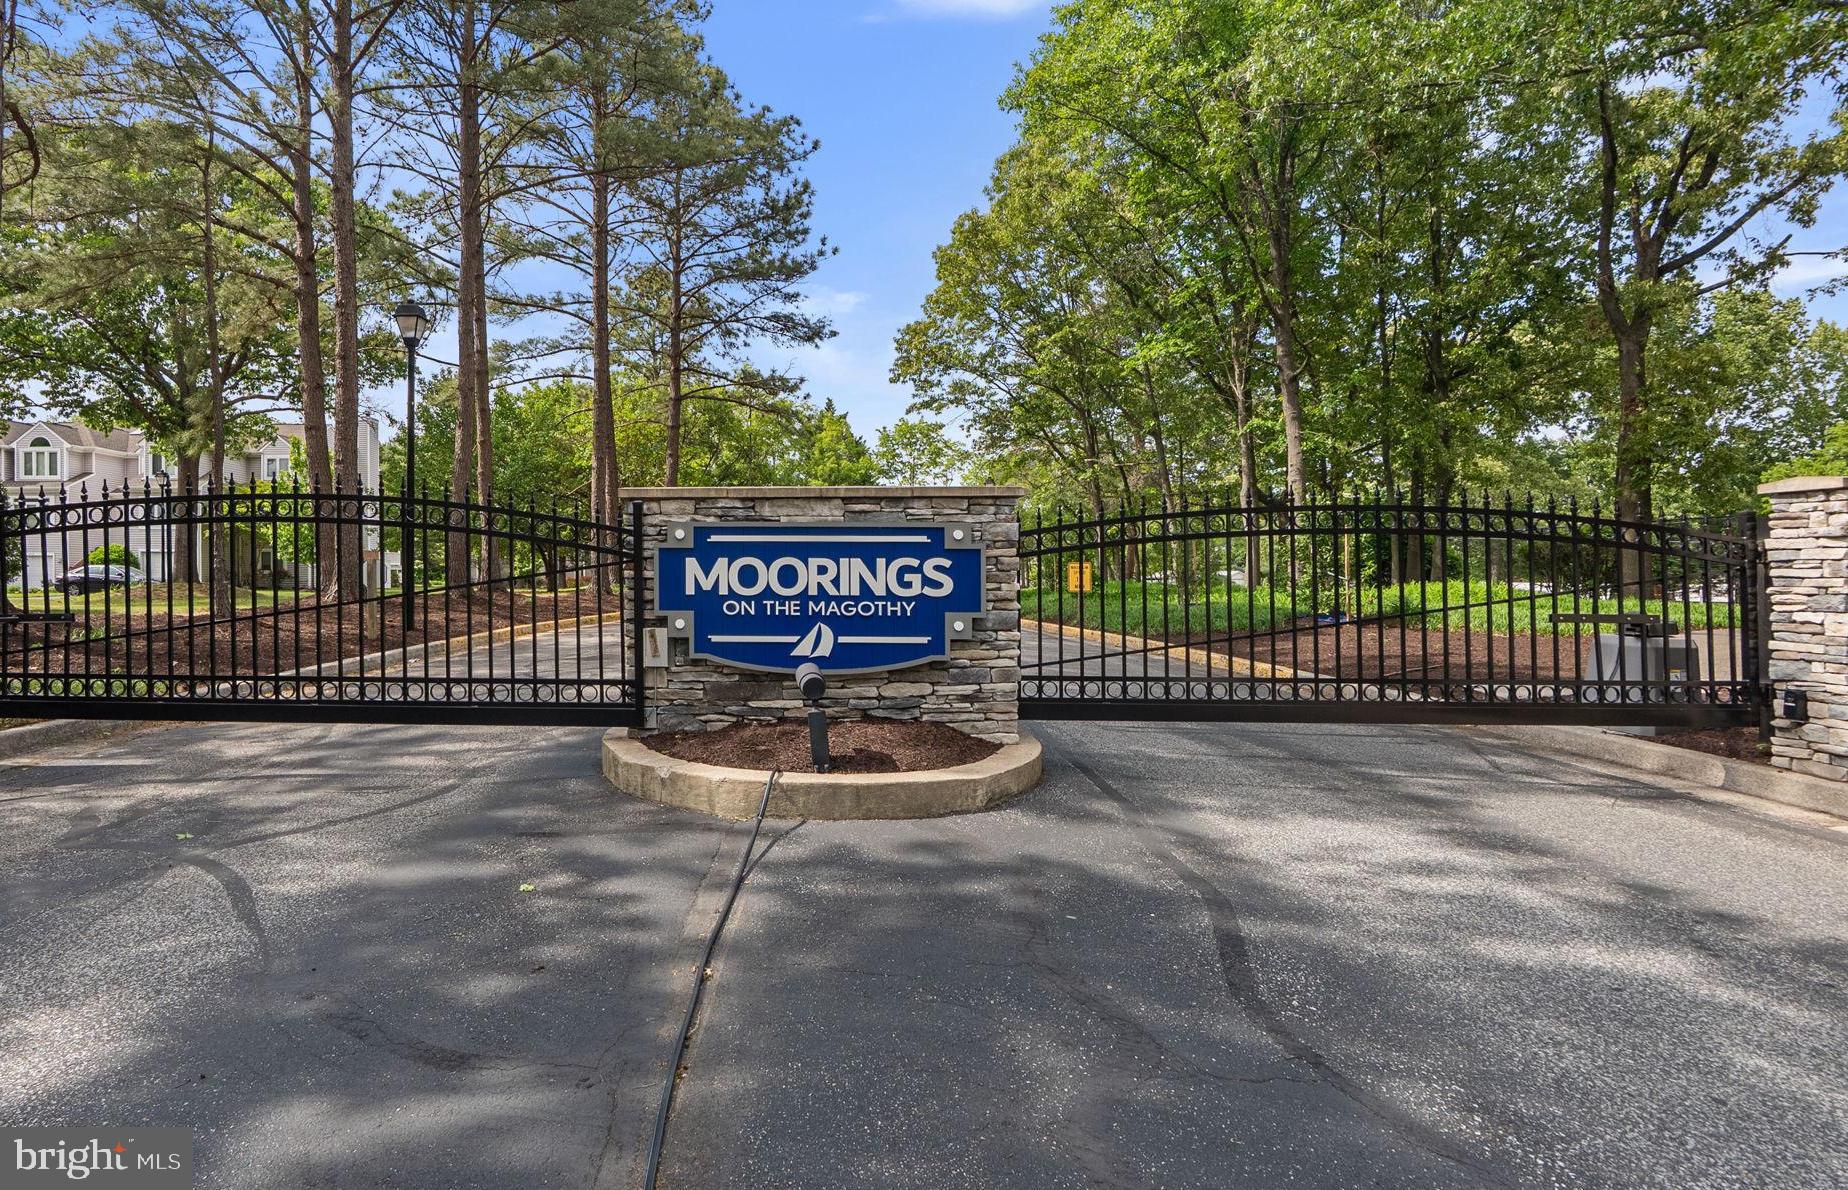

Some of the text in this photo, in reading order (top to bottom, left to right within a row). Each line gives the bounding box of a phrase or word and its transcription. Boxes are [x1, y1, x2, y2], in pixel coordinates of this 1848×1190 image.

[685, 557, 954, 597] MOORINGS
[722, 600, 916, 617] ON THE MAGOTHY
